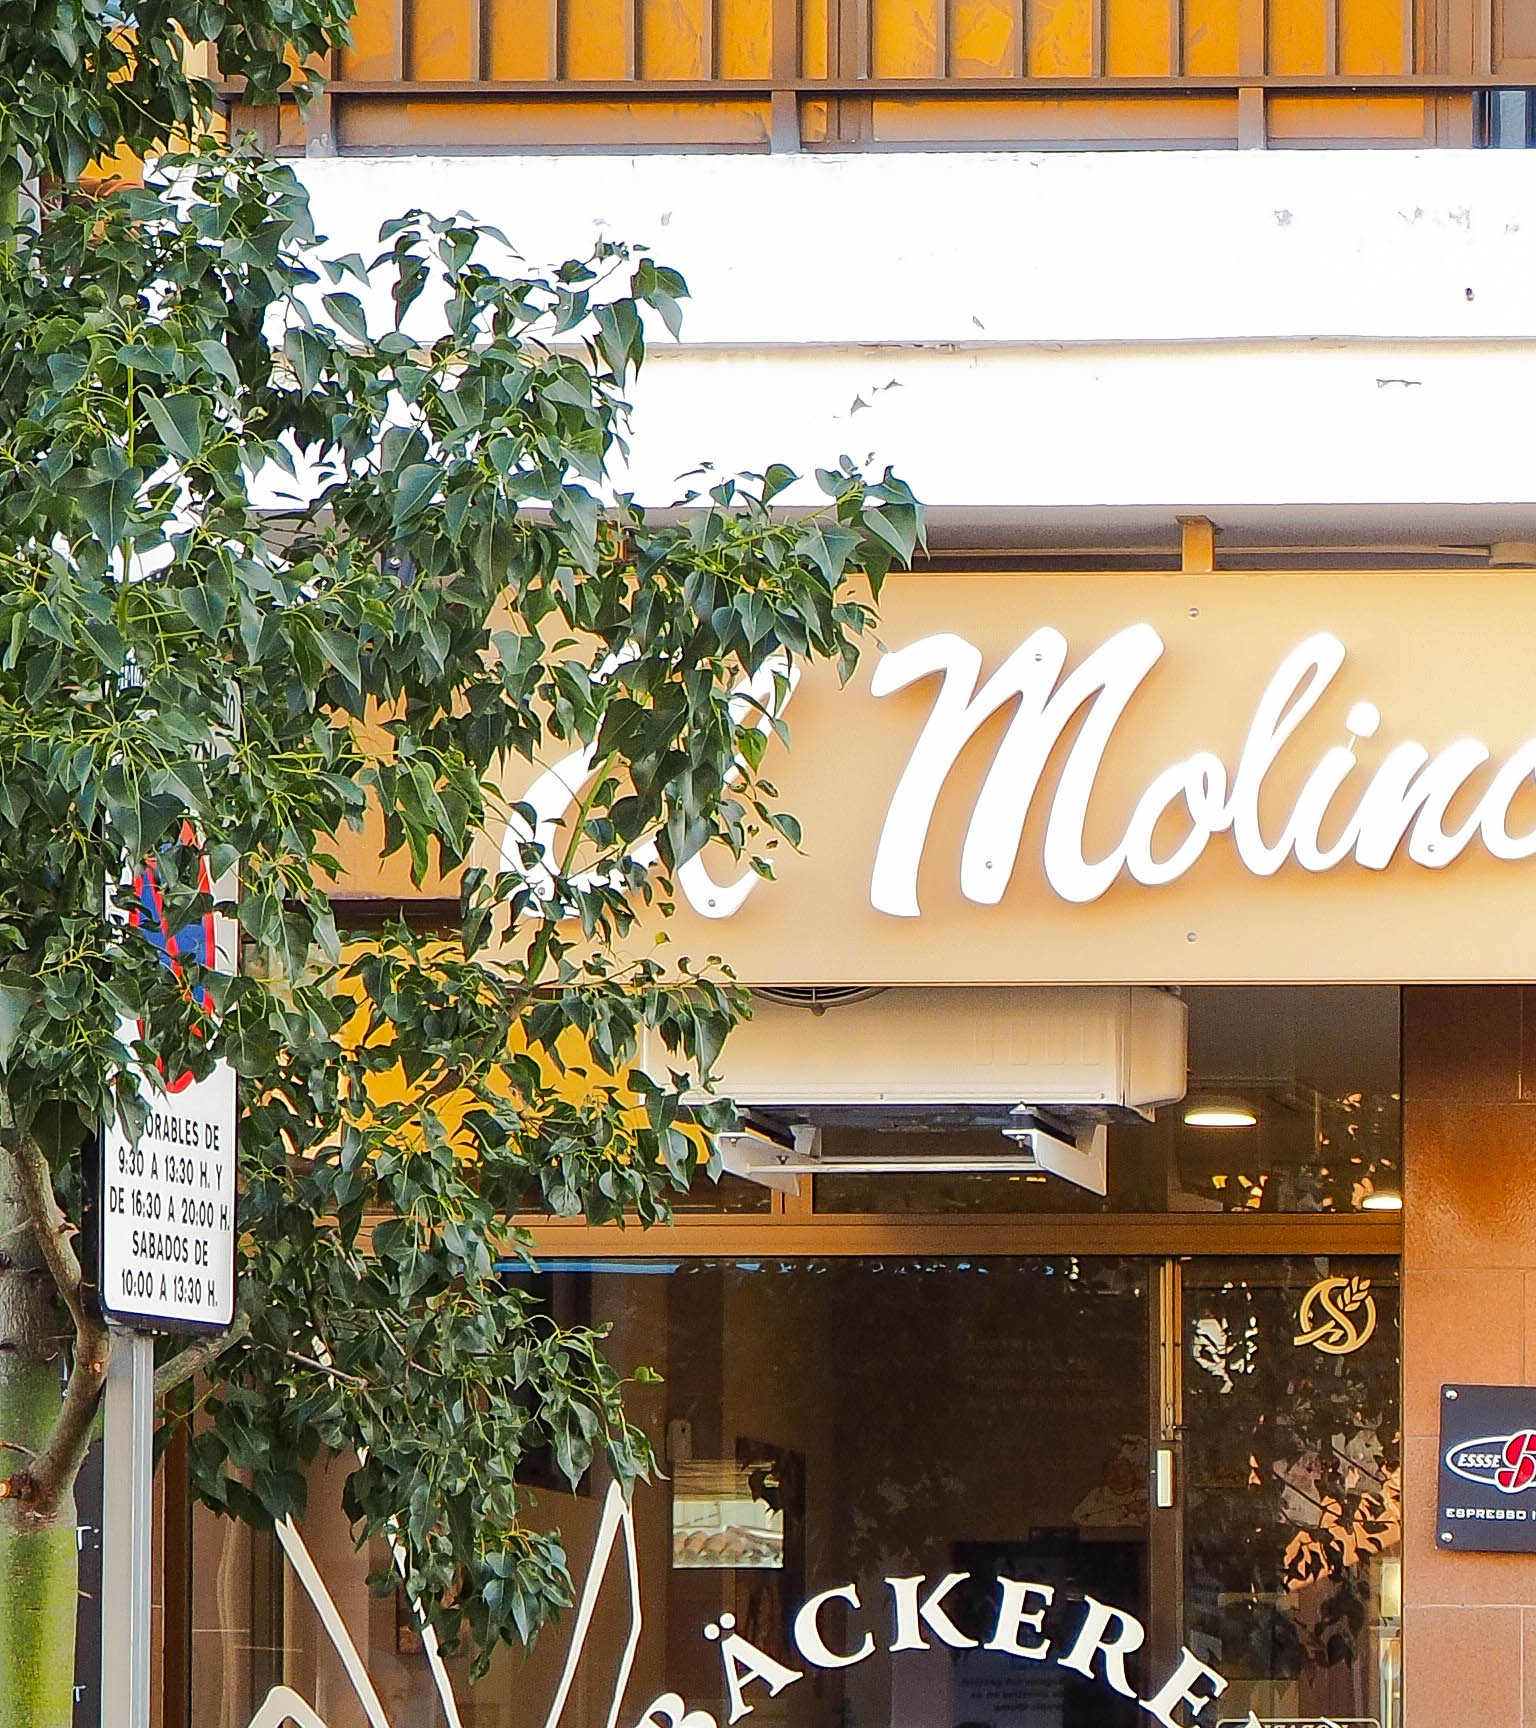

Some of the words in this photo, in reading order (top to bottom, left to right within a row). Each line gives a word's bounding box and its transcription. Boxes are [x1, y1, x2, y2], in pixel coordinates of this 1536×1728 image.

[144, 1112, 200, 1148] ORABLES
[204, 1122, 221, 1152] DE
[117, 1145, 145, 1177] 9:30
[150, 1151, 159, 1181] A
[164, 1154, 195, 1187] 13:30
[215, 1163, 223, 1192] Y
[109, 1185, 126, 1215] DE
[131, 1188, 162, 1221] 16:30
[167, 1195, 177, 1224] A
[181, 1198, 215, 1229] 20:00
[131, 1229, 190, 1264] SABADOS
[193, 1239, 209, 1267] DE
[121, 1267, 154, 1300] 10:00
[159, 1273, 168, 1302] A
[173, 1274, 202, 1305] 13:30
[1445, 1507, 1527, 1521] ESPRESSO
